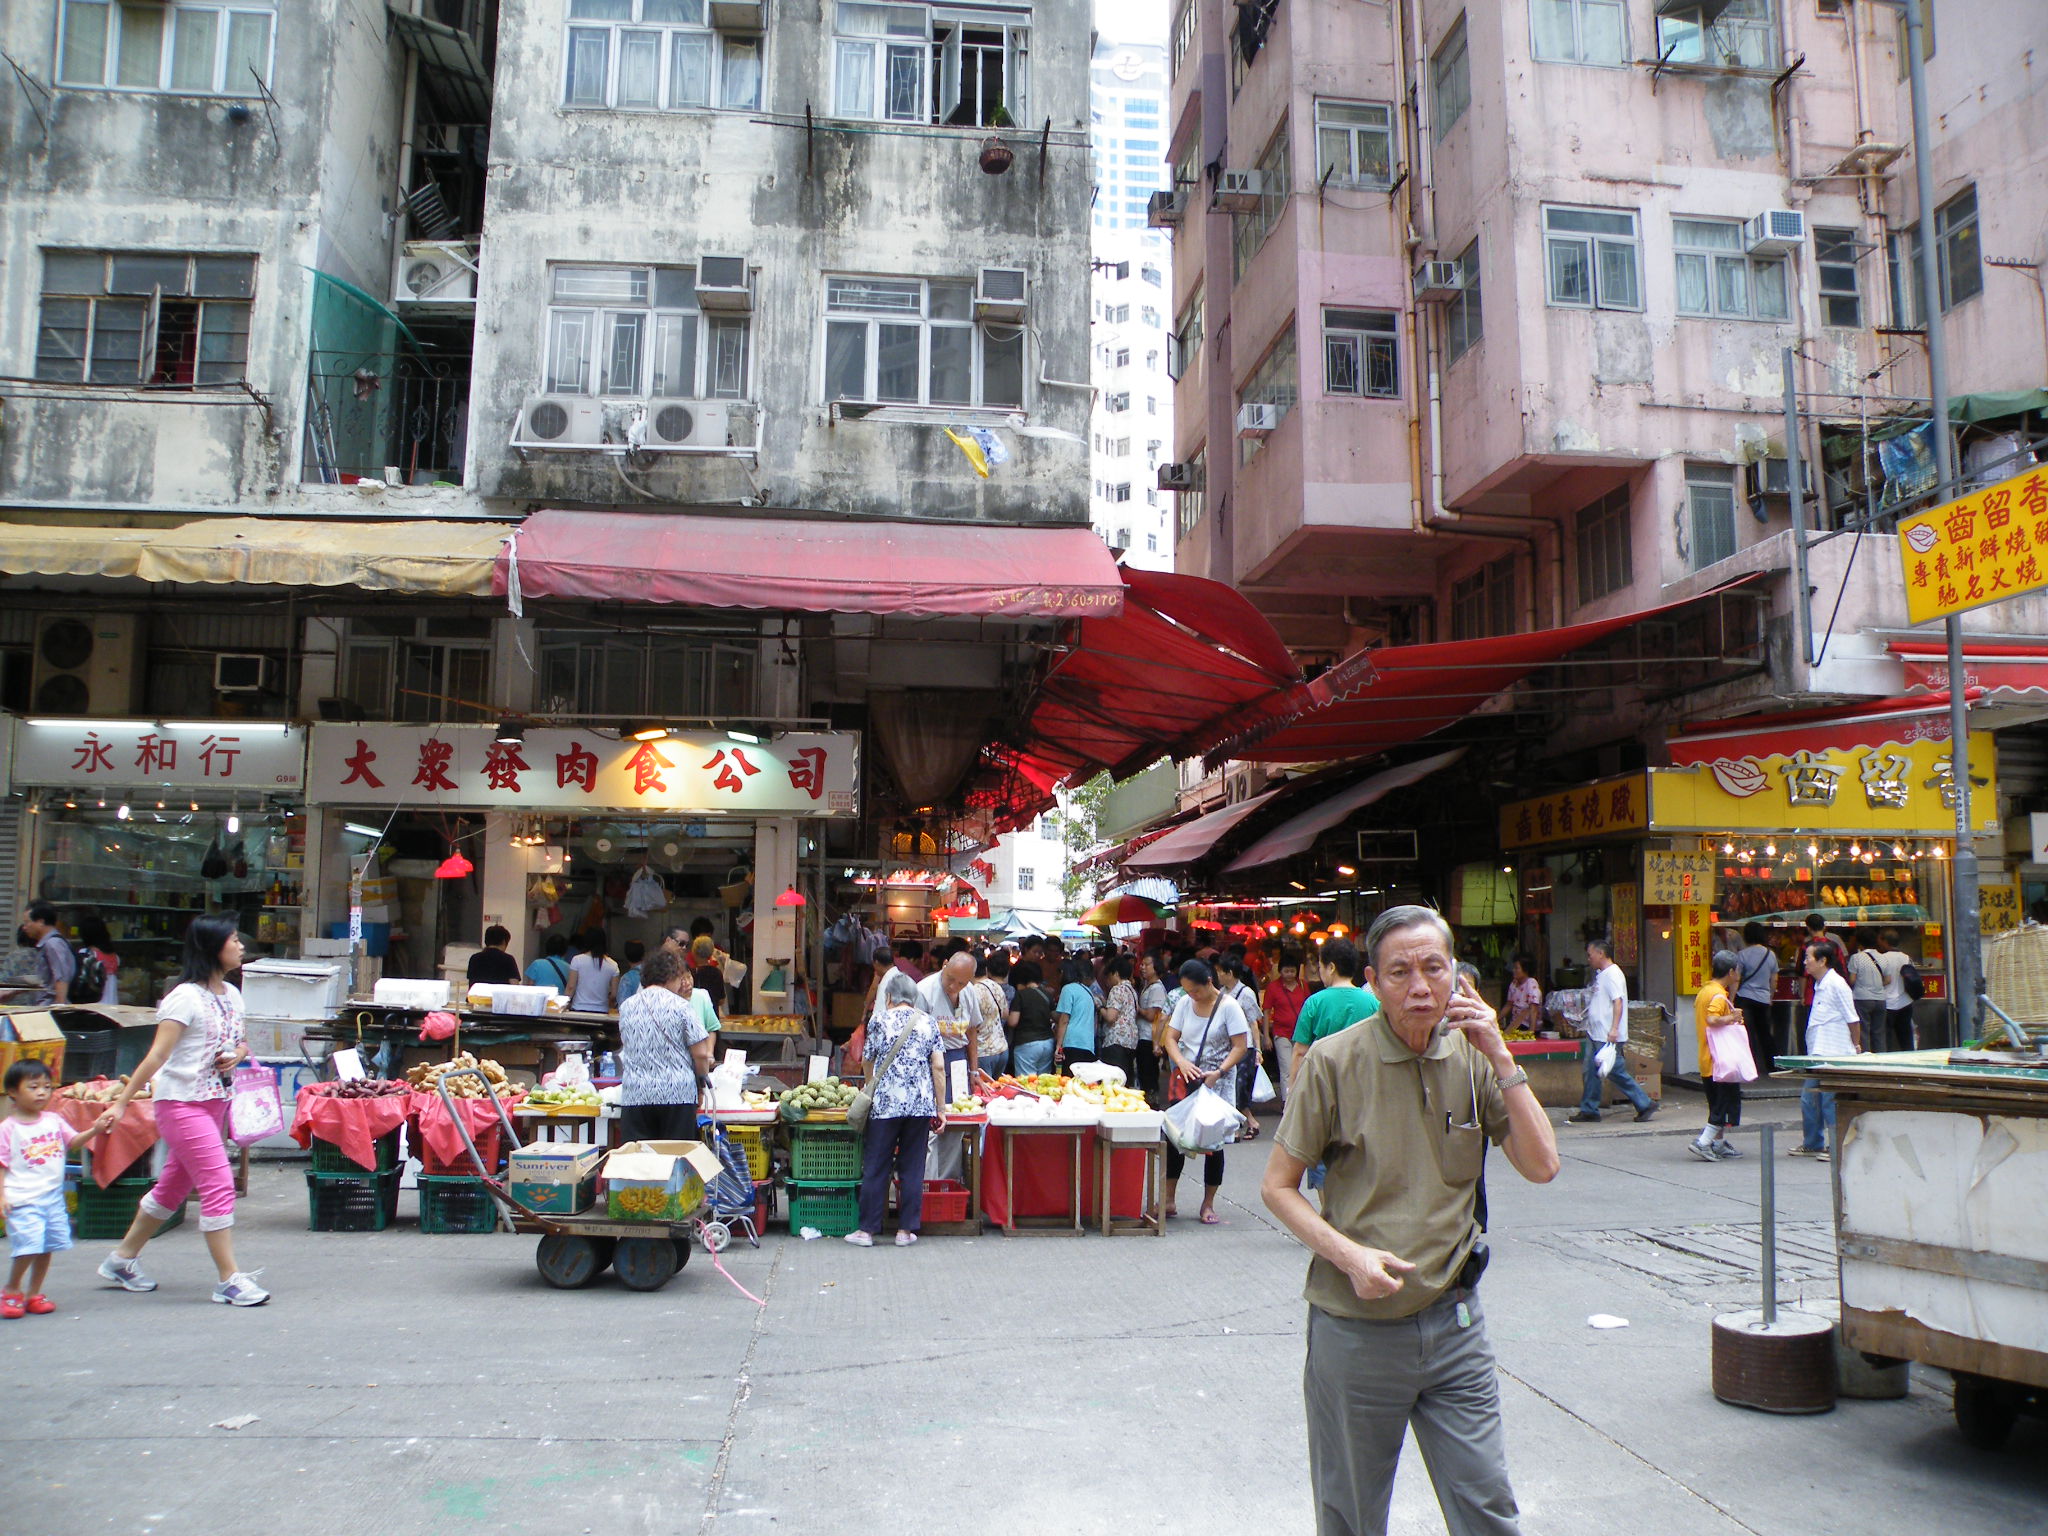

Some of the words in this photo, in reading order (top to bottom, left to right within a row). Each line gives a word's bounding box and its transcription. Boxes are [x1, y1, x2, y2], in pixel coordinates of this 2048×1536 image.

[1943, 474, 2048, 545] 齒留香
[71, 731, 241, 777] 永和行
[515, 1161, 569, 1171] Sunriver
